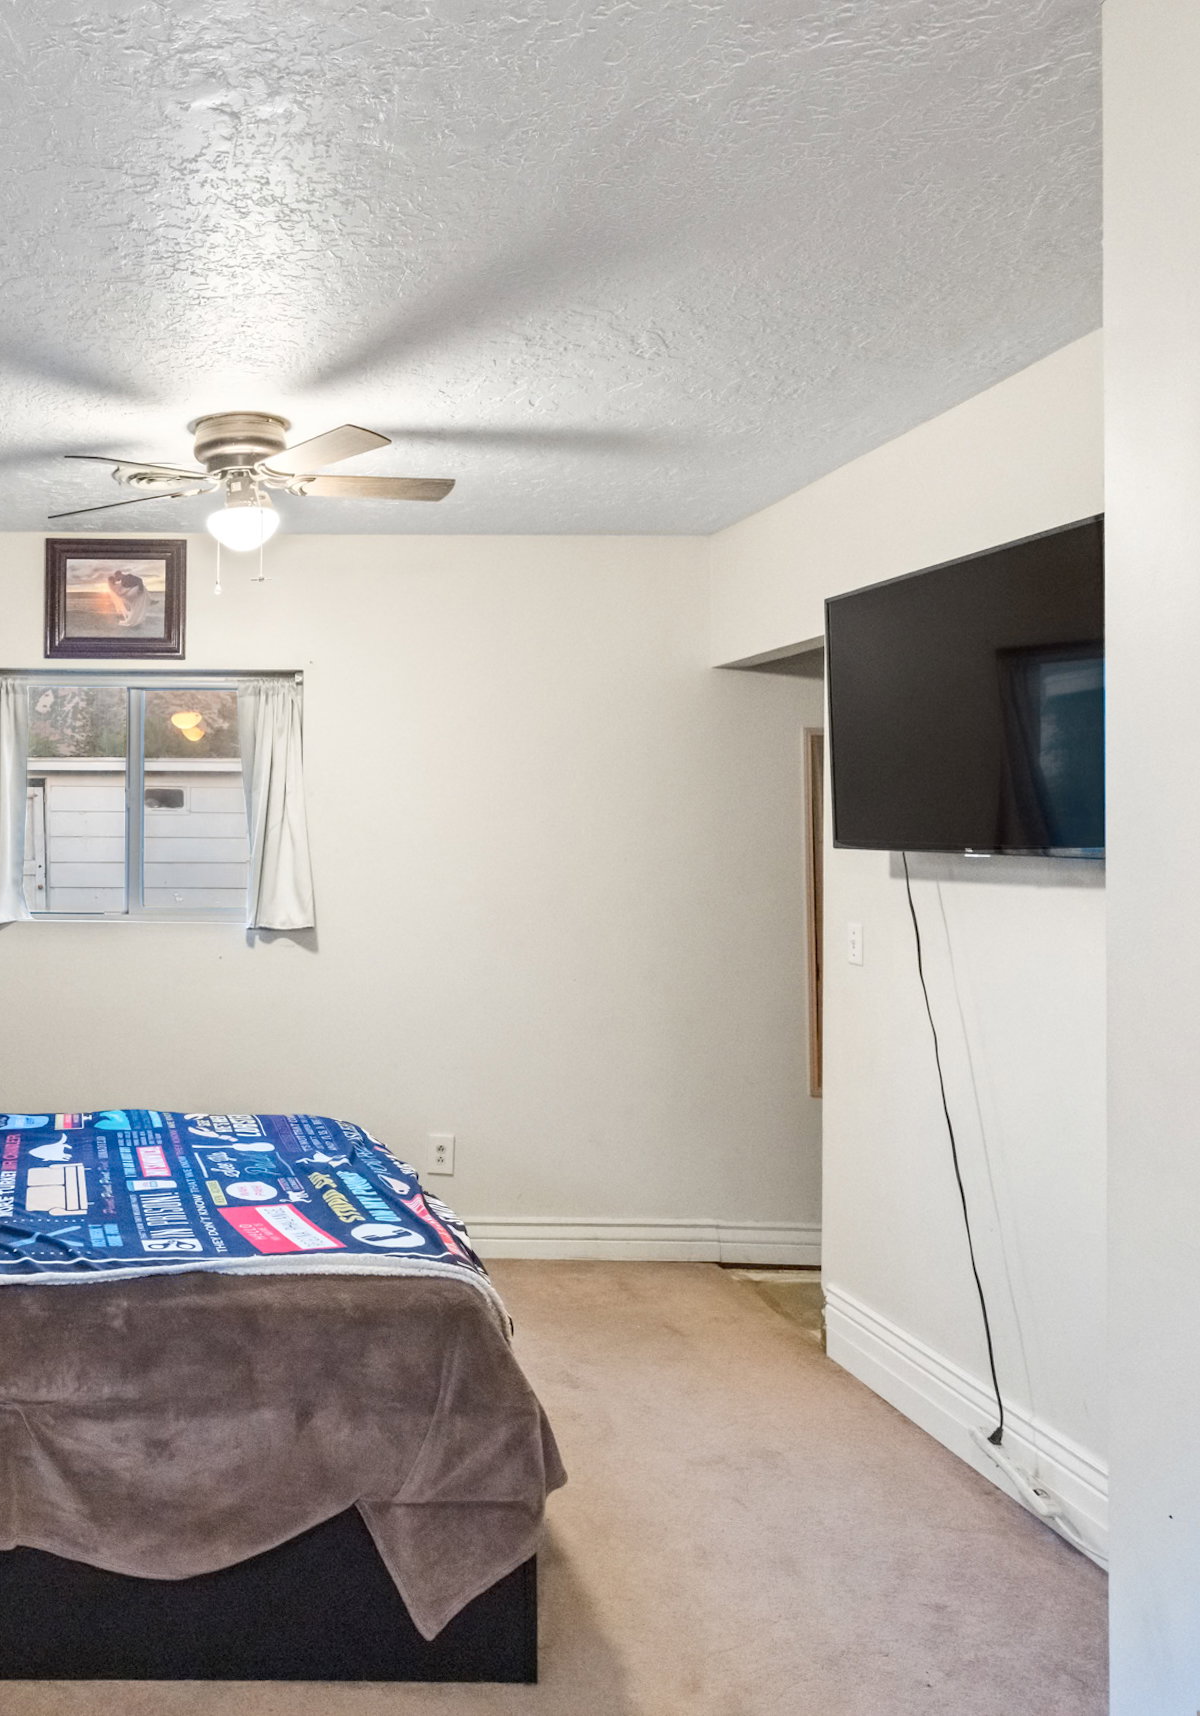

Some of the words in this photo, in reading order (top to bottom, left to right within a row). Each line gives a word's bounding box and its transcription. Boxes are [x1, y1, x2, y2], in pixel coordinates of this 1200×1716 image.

[177, 1156, 191, 1169] KNOW
[182, 1168, 195, 1178] WE
[186, 1179, 200, 1194] THAT
[139, 1192, 191, 1227] PRISON!
[192, 1194, 209, 1216] KNOW
[355, 1196, 390, 1210] MY
[368, 1209, 402, 1222] ON
[202, 1216, 219, 1237] DON'T
[150, 1229, 195, 1239] IN
[210, 1236, 228, 1253] THEY
